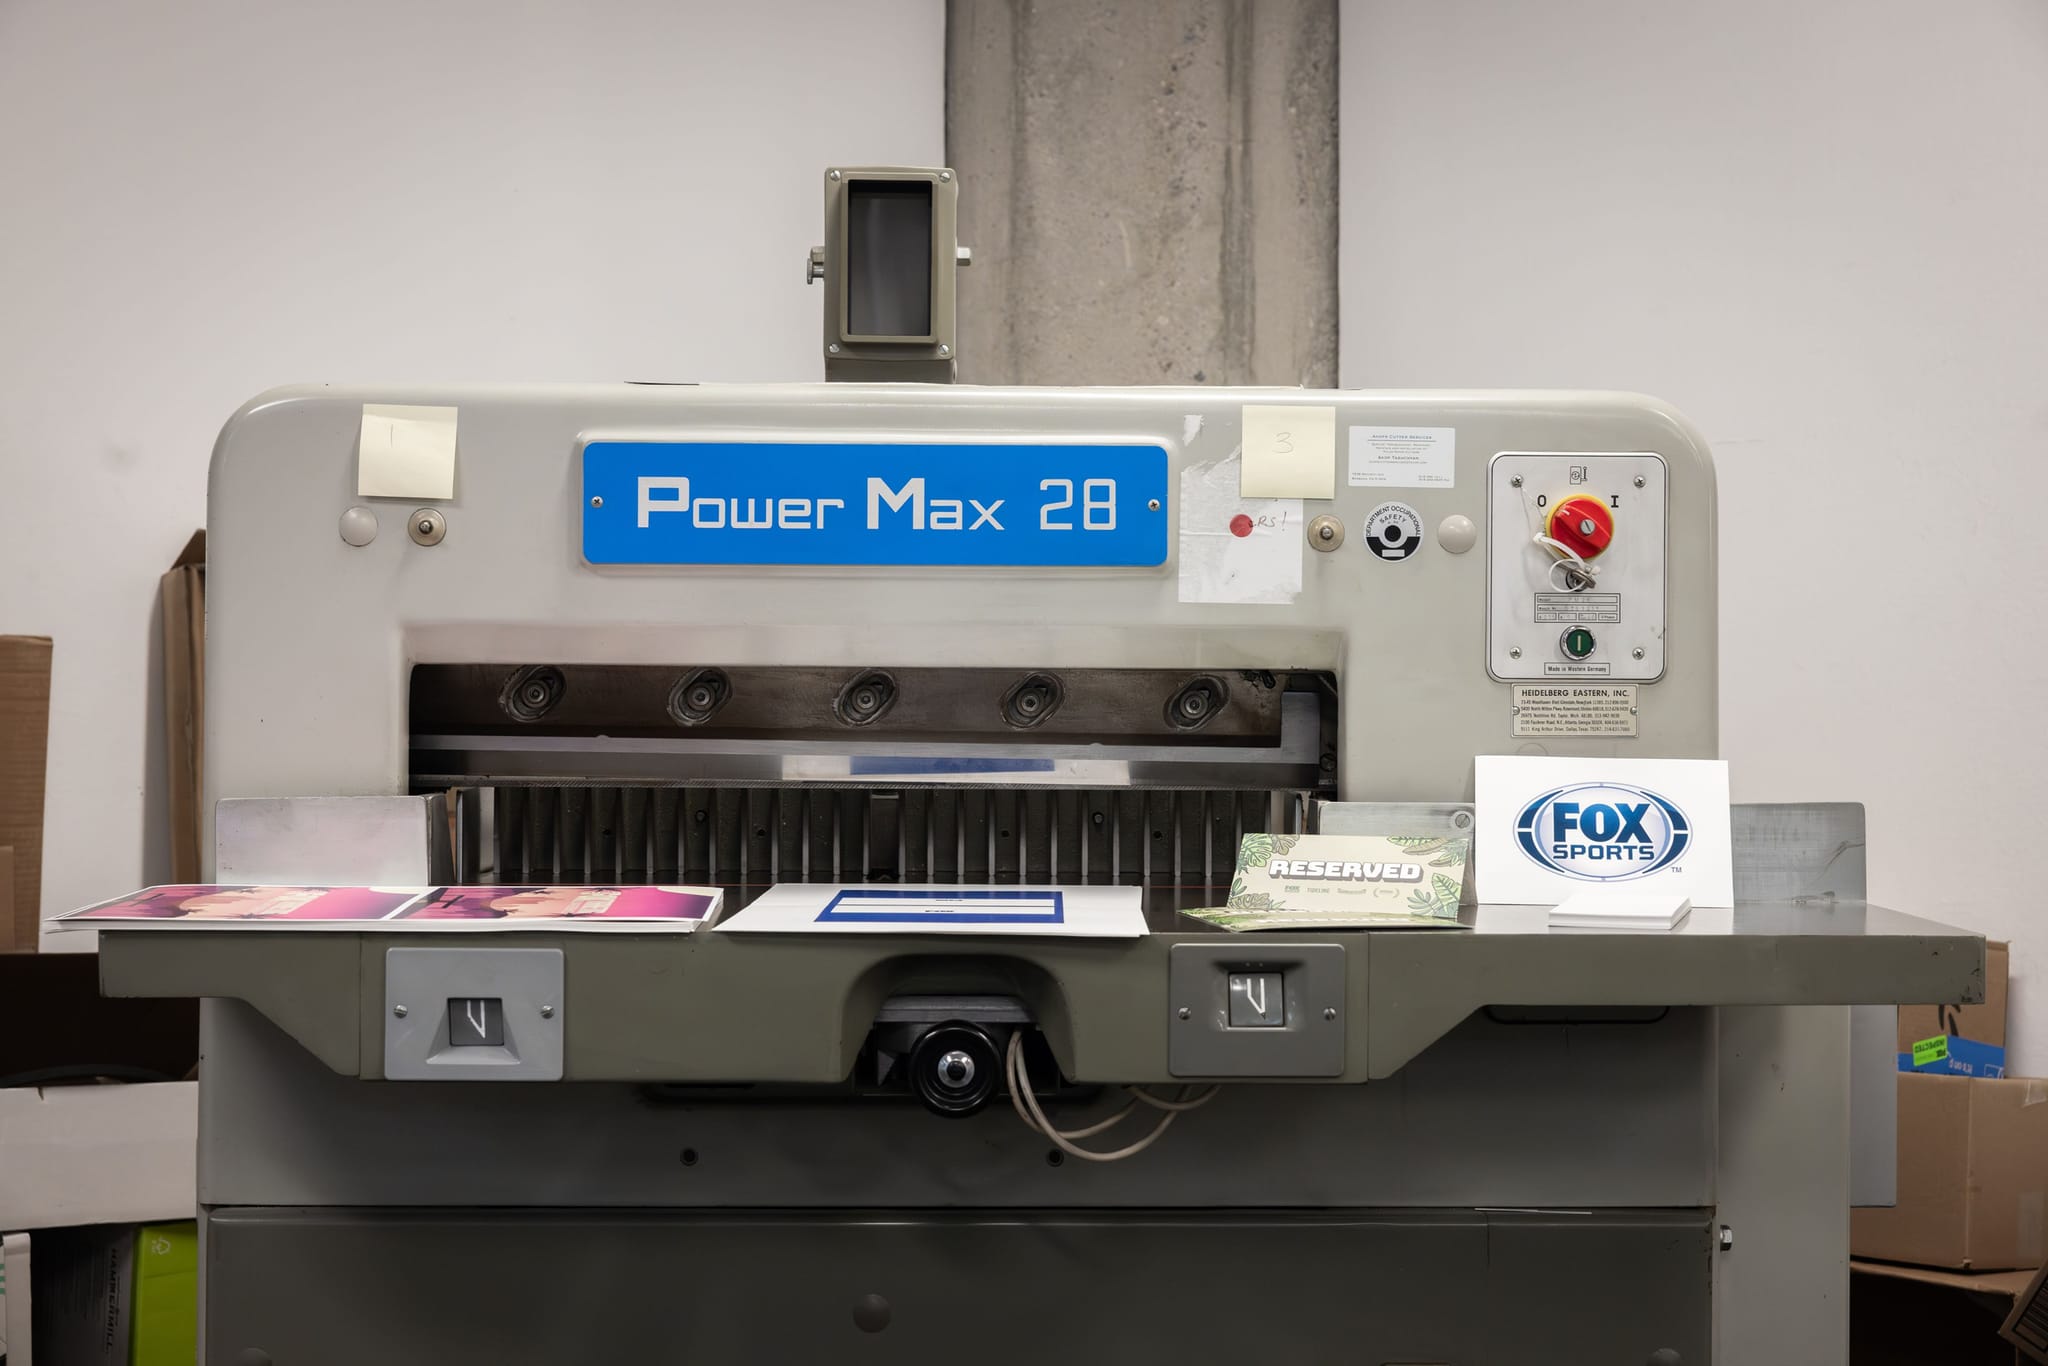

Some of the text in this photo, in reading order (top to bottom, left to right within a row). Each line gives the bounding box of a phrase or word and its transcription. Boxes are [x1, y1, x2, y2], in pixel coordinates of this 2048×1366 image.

[1272, 432, 1294, 454] 3
[637, 476, 1117, 531] Power Max 28
[1366, 505, 1421, 537] DEPARTMENT OCCUPATIONAL
[1379, 513, 1408, 524] SAFETY
[1521, 689, 1630, 698] HEIDELBERG EASTERN, INC.
[1553, 802, 1653, 843] FOX
[1552, 844, 1655, 860] SPORTS
[1269, 860, 1424, 883] RESERVED
